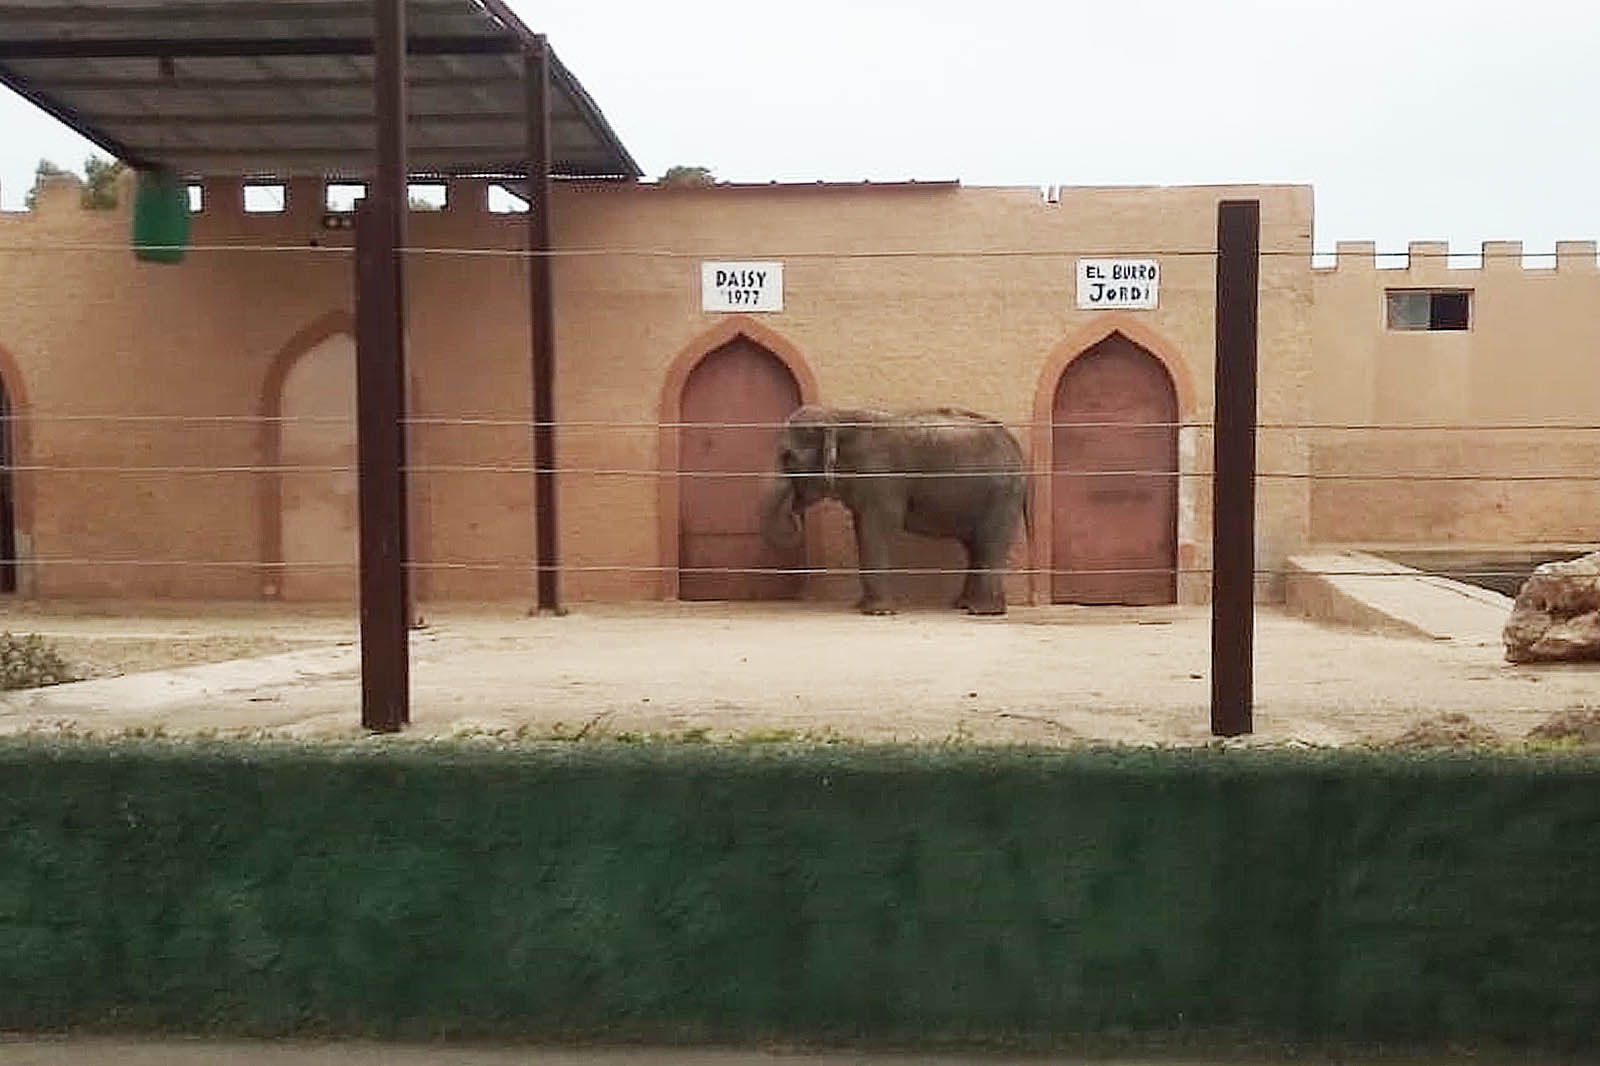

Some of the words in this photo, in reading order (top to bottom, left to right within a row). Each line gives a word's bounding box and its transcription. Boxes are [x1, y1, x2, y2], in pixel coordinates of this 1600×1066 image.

[716, 270, 766, 288] DAISY
[1086, 265, 1105, 279] EL
[1112, 264, 1156, 280] BURRO
